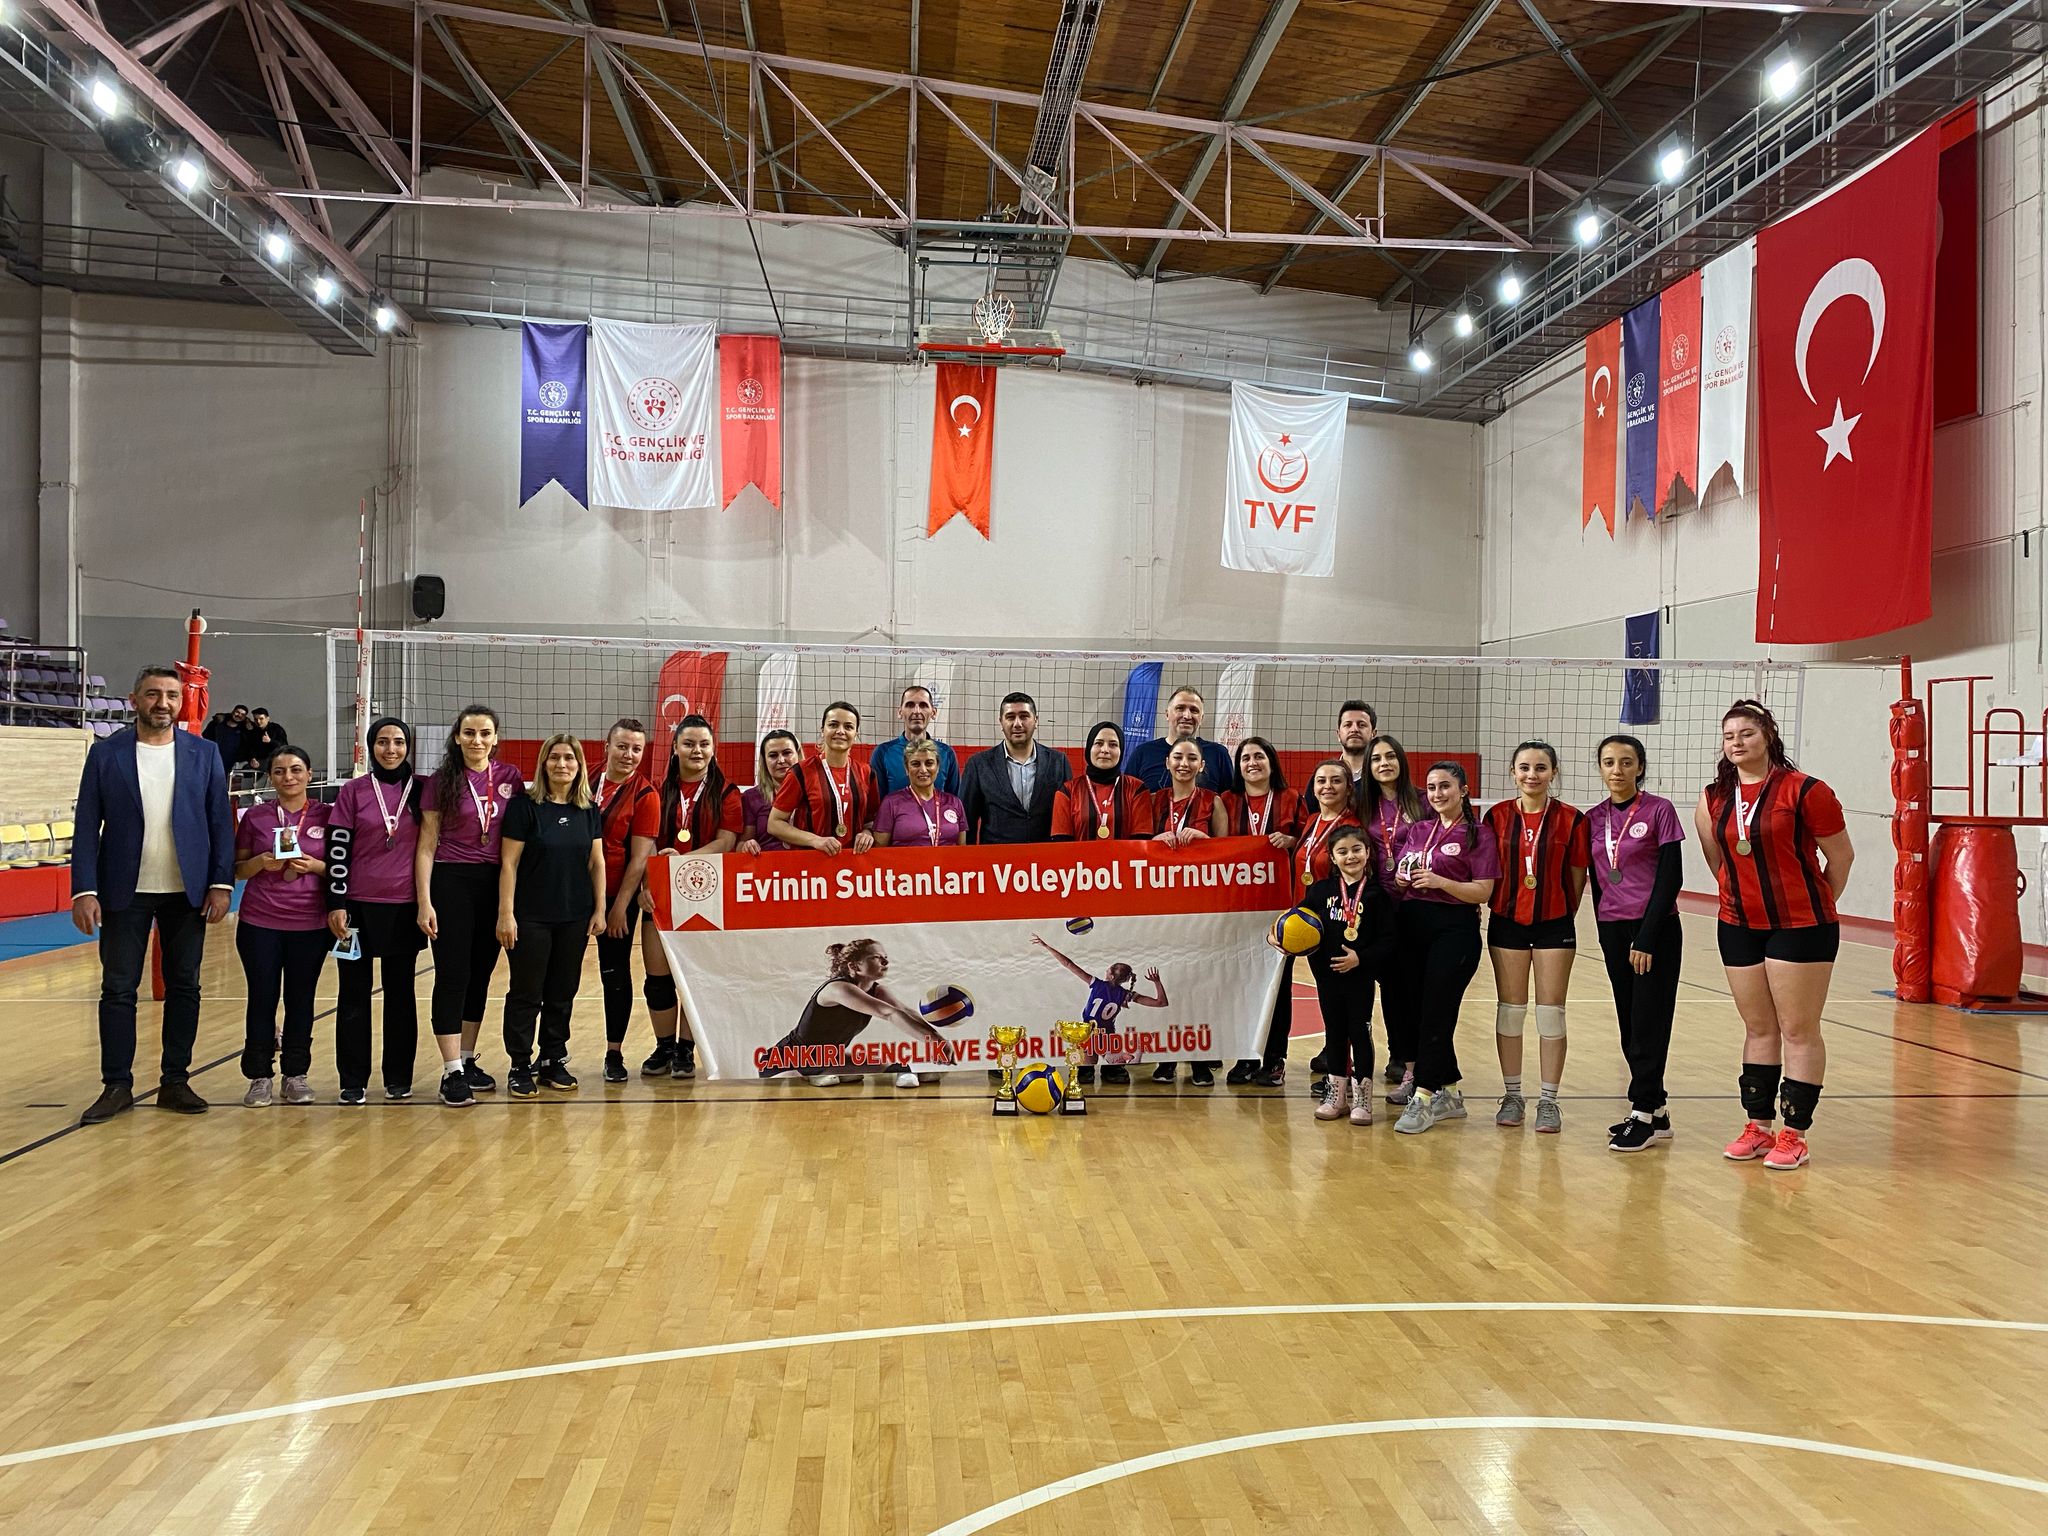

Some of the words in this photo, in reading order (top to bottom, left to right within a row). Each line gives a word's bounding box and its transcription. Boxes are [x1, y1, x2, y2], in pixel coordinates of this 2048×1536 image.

[540, 410, 570, 418] GENÇLİK
[1648, 403, 1655, 412] VE
[629, 434, 686, 450] GENÇLİK
[690, 434, 704, 445] VE
[604, 448, 634, 462] SPOR
[639, 448, 704, 462] BAKANLIĞI
[1244, 499, 1316, 533] TVF
[838, 784, 845, 796] 7
[736, 869, 828, 902] Evinin
[836, 866, 985, 900] Sultanları
[992, 860, 1122, 898] Voleybol
[1130, 860, 1275, 888] Turnuvası
[1090, 998, 1118, 1020] 10
[754, 1043, 846, 1072] ÇANKIRI
[850, 1035, 950, 1067] GENÇLİK
[952, 1039, 980, 1062] VE
[986, 1036, 1044, 1060] SOR
